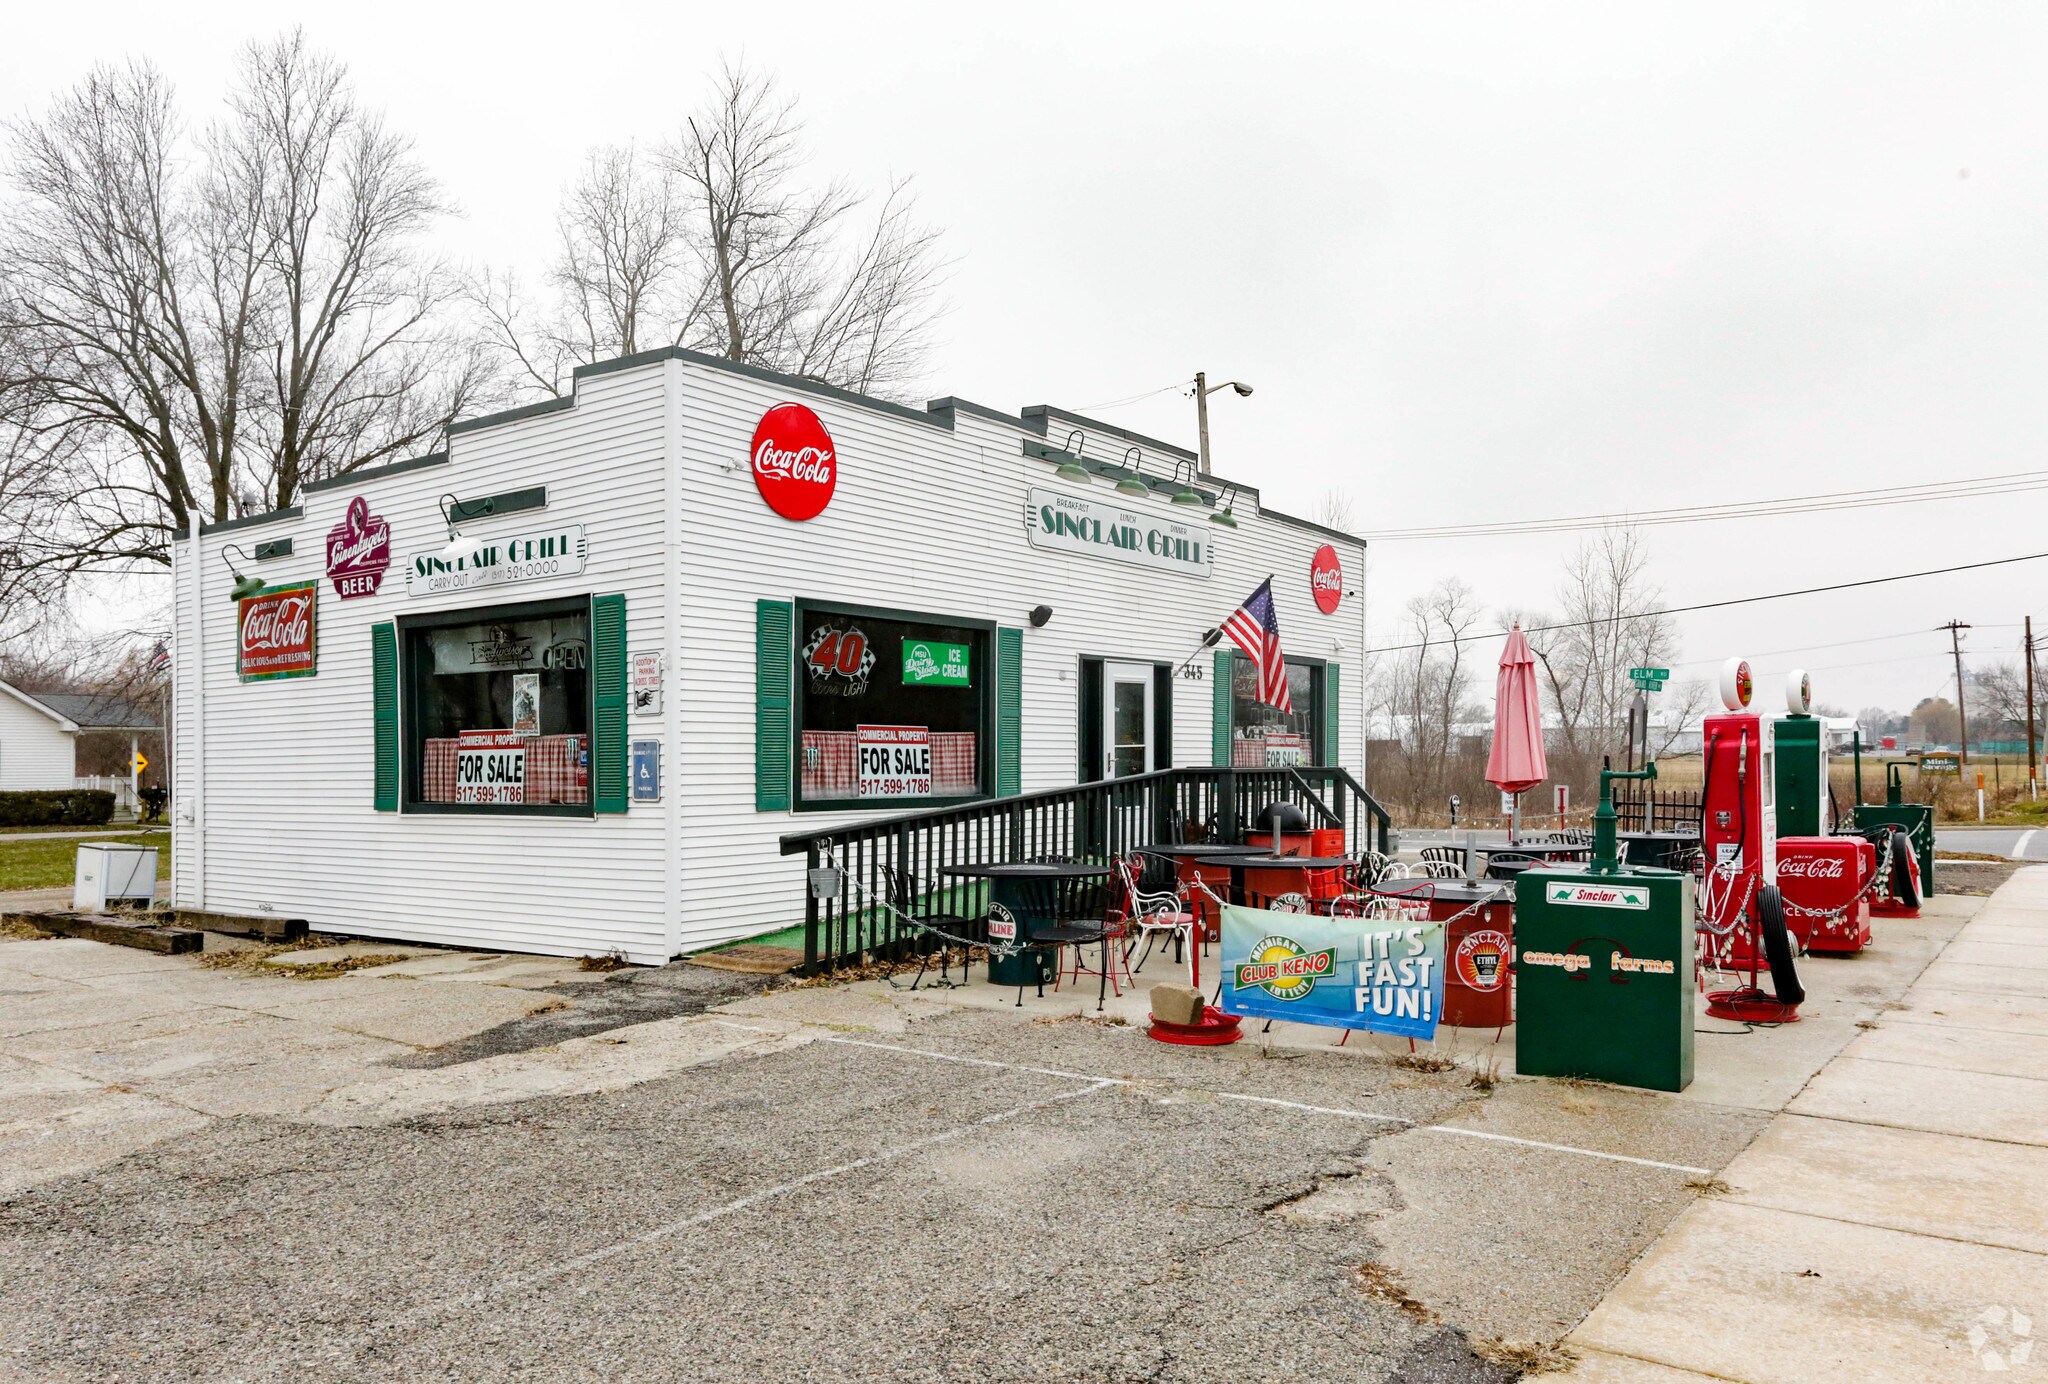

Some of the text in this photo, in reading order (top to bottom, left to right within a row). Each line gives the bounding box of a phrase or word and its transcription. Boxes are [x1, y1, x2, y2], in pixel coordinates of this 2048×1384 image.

[755, 439, 833, 484] Coca-Cola
[1056, 498, 1089, 513] BREAKFAST
[1120, 513, 1137, 524] LUNCH
[1041, 505, 1205, 565] SINCLAIR GRILL
[1170, 525, 1188, 536] DINNER
[327, 524, 388, 573] Leinenkugel's
[508, 535, 572, 563] GRILL
[429, 577, 451, 591] CARRY
[453, 574, 468, 587] OUT
[507, 560, 559, 579] 521-0000
[1313, 566, 1341, 590] Coca-Cola
[342, 576, 374, 595] BEER
[258, 601, 279, 611] DRINK
[242, 596, 312, 652] Coca-Cola
[542, 646, 586, 670] OPEN
[810, 630, 867, 676] 40
[948, 649, 961, 662] ICE
[639, 667, 655, 676] PARKING
[942, 664, 967, 678] CREAM
[1184, 664, 1202, 680] 345
[1634, 669, 1654, 679] ELM
[843, 681, 869, 696] LIGHT
[460, 735, 494, 747] COMMERCIAL
[859, 729, 927, 742] COMMERCIAL PROPERTY
[860, 748, 930, 775] FOR SALE
[1267, 750, 1299, 767] FOR SALE
[458, 755, 523, 783] FOR SALE
[456, 785, 522, 802] 517-599-1786
[860, 778, 930, 795] 517-599-1786
[1776, 858, 1845, 878] Coca-Cola
[1272, 895, 1306, 911] SINCLAIR
[1576, 889, 1617, 902] Sinclair
[1783, 907, 1801, 917] ICE
[1252, 937, 1299, 961] MICHIGAN
[1363, 926, 1426, 960] IT'S
[1460, 933, 1508, 956] SINCLAIR
[1241, 952, 1329, 983] CLUB KENO
[1476, 956, 1497, 965] ETHYL
[1522, 951, 1674, 974] omega farms
[1358, 957, 1435, 988] FAST
[1269, 979, 1310, 998] LOTTERY
[1355, 987, 1432, 1022] FUN!
